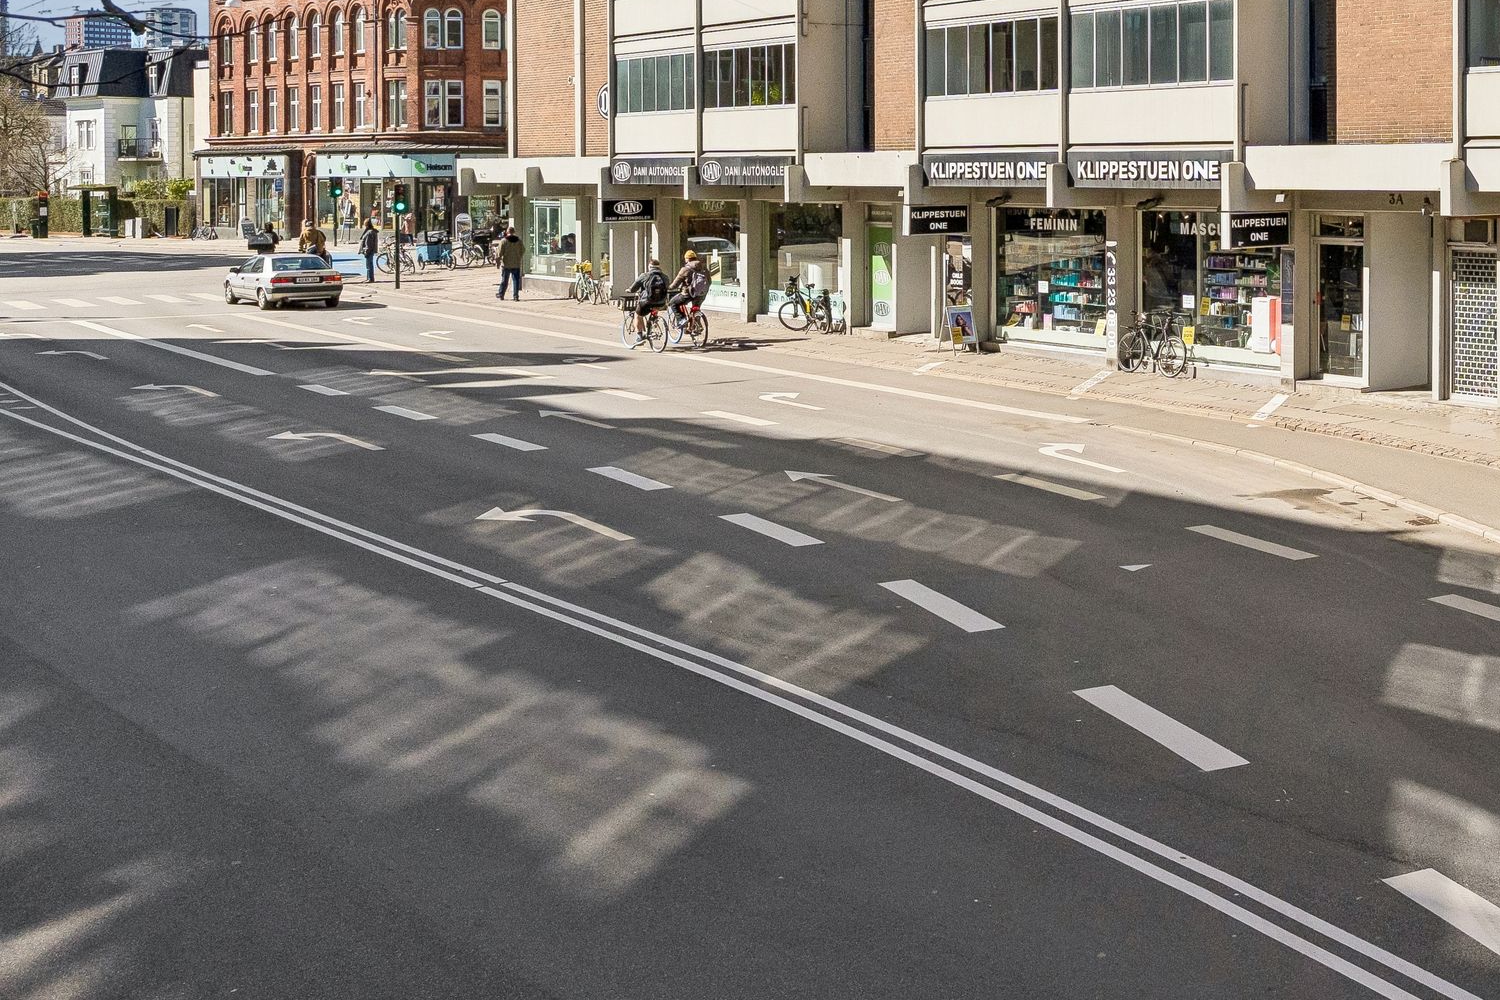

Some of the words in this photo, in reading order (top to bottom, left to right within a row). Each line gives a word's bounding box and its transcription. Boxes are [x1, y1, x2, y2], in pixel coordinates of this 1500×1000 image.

[633, 166, 648, 176] DANI
[648, 166, 684, 176] AUTONØGLE
[724, 166, 740, 176] DANI
[742, 166, 784, 176] AUTONØGLE
[930, 162, 1014, 178] KLIPPESTUEN
[1016, 161, 1046, 178] ONE
[1077, 160, 1178, 179] KLIPPESTUEN
[1182, 160, 1220, 180] ONE
[1388, 194, 1404, 205] 3A
[617, 202, 640, 213] DANI
[911, 210, 966, 219] KLIPPESTUEN
[929, 222, 948, 230] ONE
[1030, 218, 1078, 231] FEMININ
[1231, 217, 1287, 228] KLIPPESTUEN
[1250, 232, 1269, 242] ONE
[1107, 268, 1116, 285] 33
[1107, 288, 1116, 306] 23
